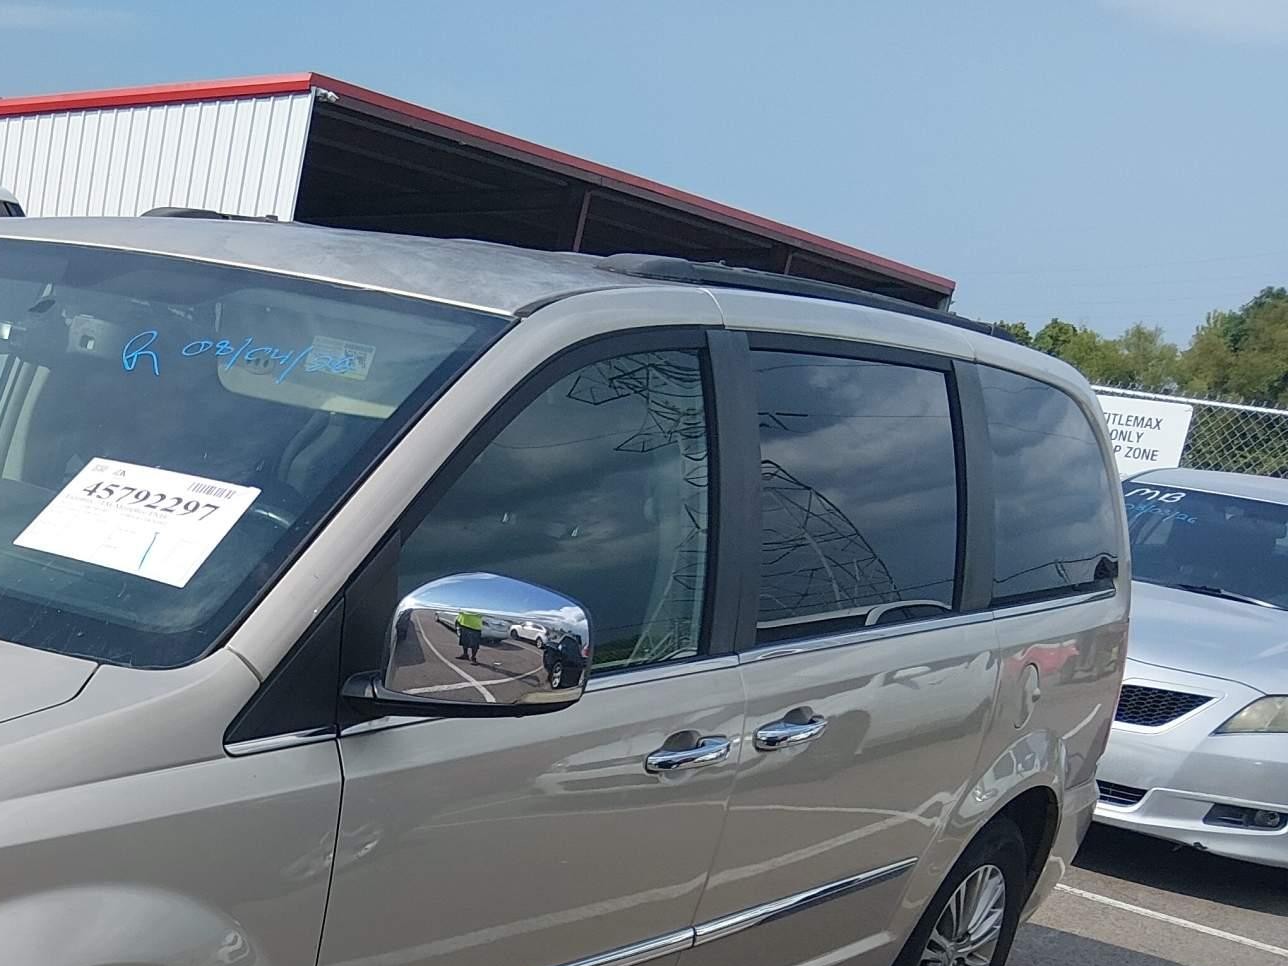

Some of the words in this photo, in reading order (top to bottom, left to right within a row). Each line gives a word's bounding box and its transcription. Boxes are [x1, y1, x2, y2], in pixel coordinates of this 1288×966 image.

[1110, 429, 1144, 443] ONLY
[1124, 446, 1159, 462] ZONE
[82, 481, 221, 521] 45792297
